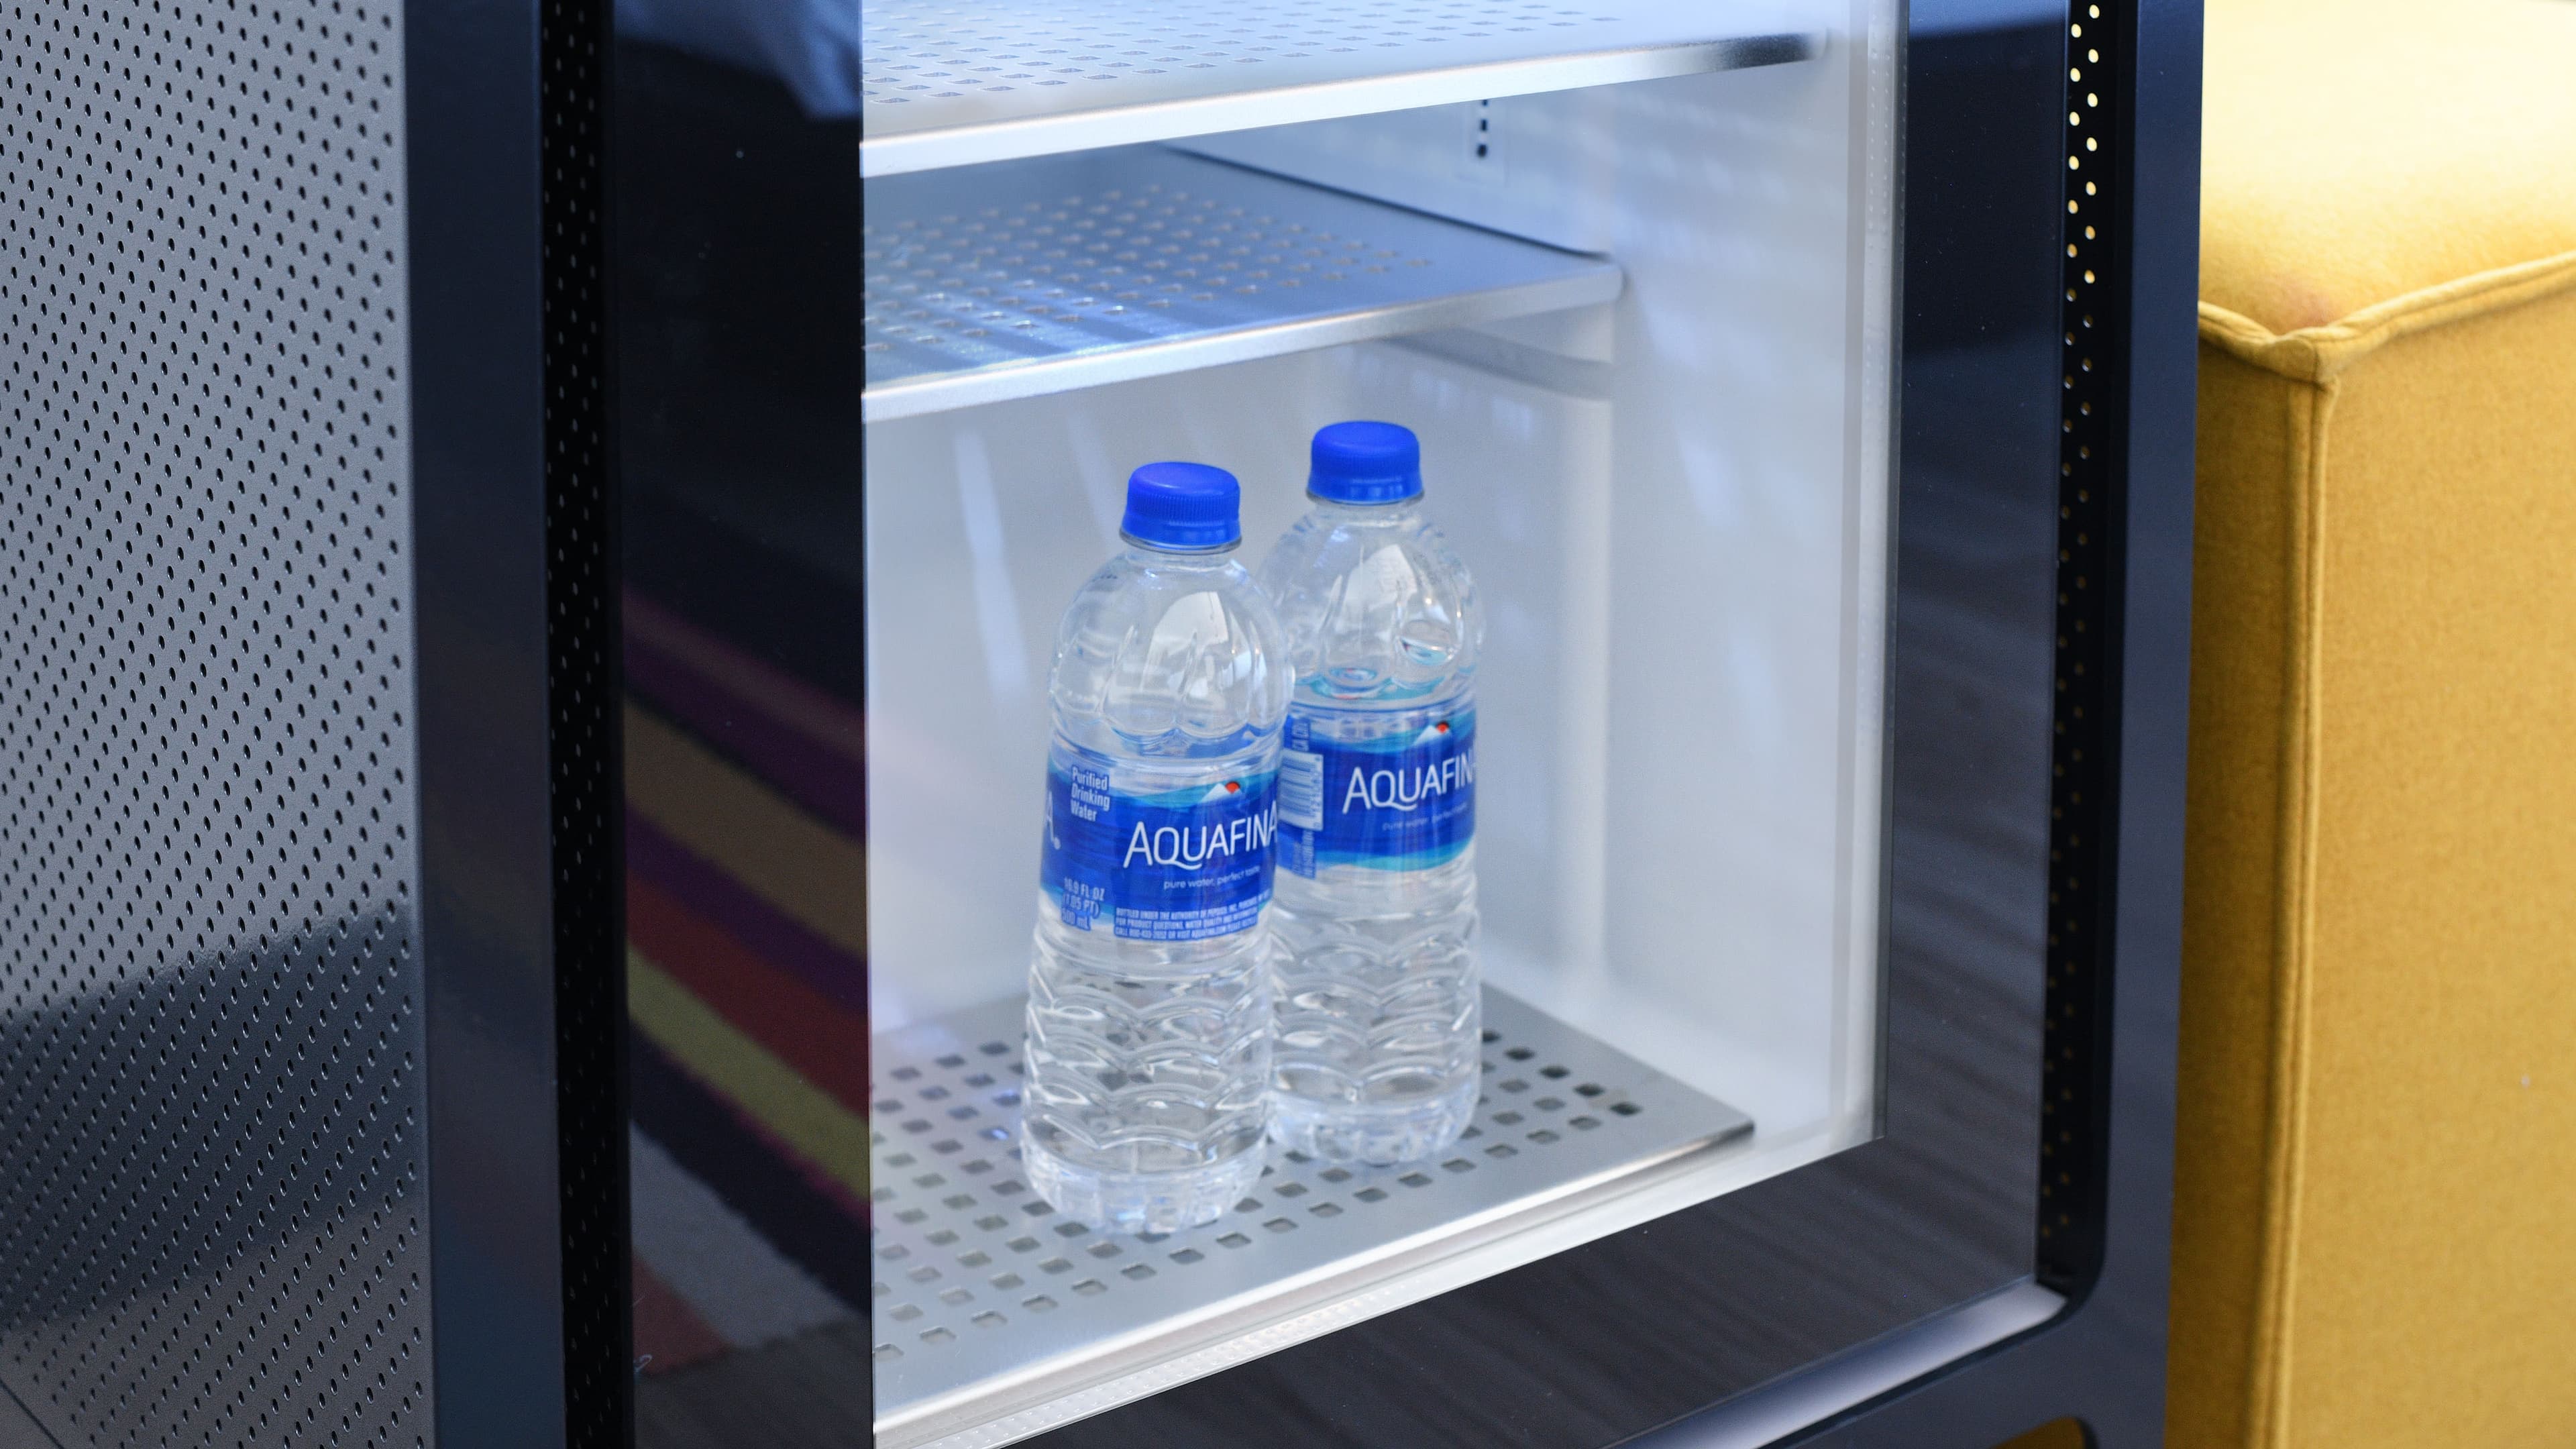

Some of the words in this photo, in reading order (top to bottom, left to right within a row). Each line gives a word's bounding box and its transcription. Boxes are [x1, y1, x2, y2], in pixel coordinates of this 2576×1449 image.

[1072, 766, 1108, 791] Purified
[1071, 782, 1111, 812] Drinking
[1070, 799, 1098, 822] Water
[1122, 800, 1277, 871] AQUAFINA
[1163, 880, 1186, 890] pure
[1216, 871, 1244, 885] perfect
[1080, 883, 1090, 898] FL
[1093, 886, 1106, 902] OZ
[1083, 899, 1099, 917] PT)
[1076, 914, 1090, 930] mL
